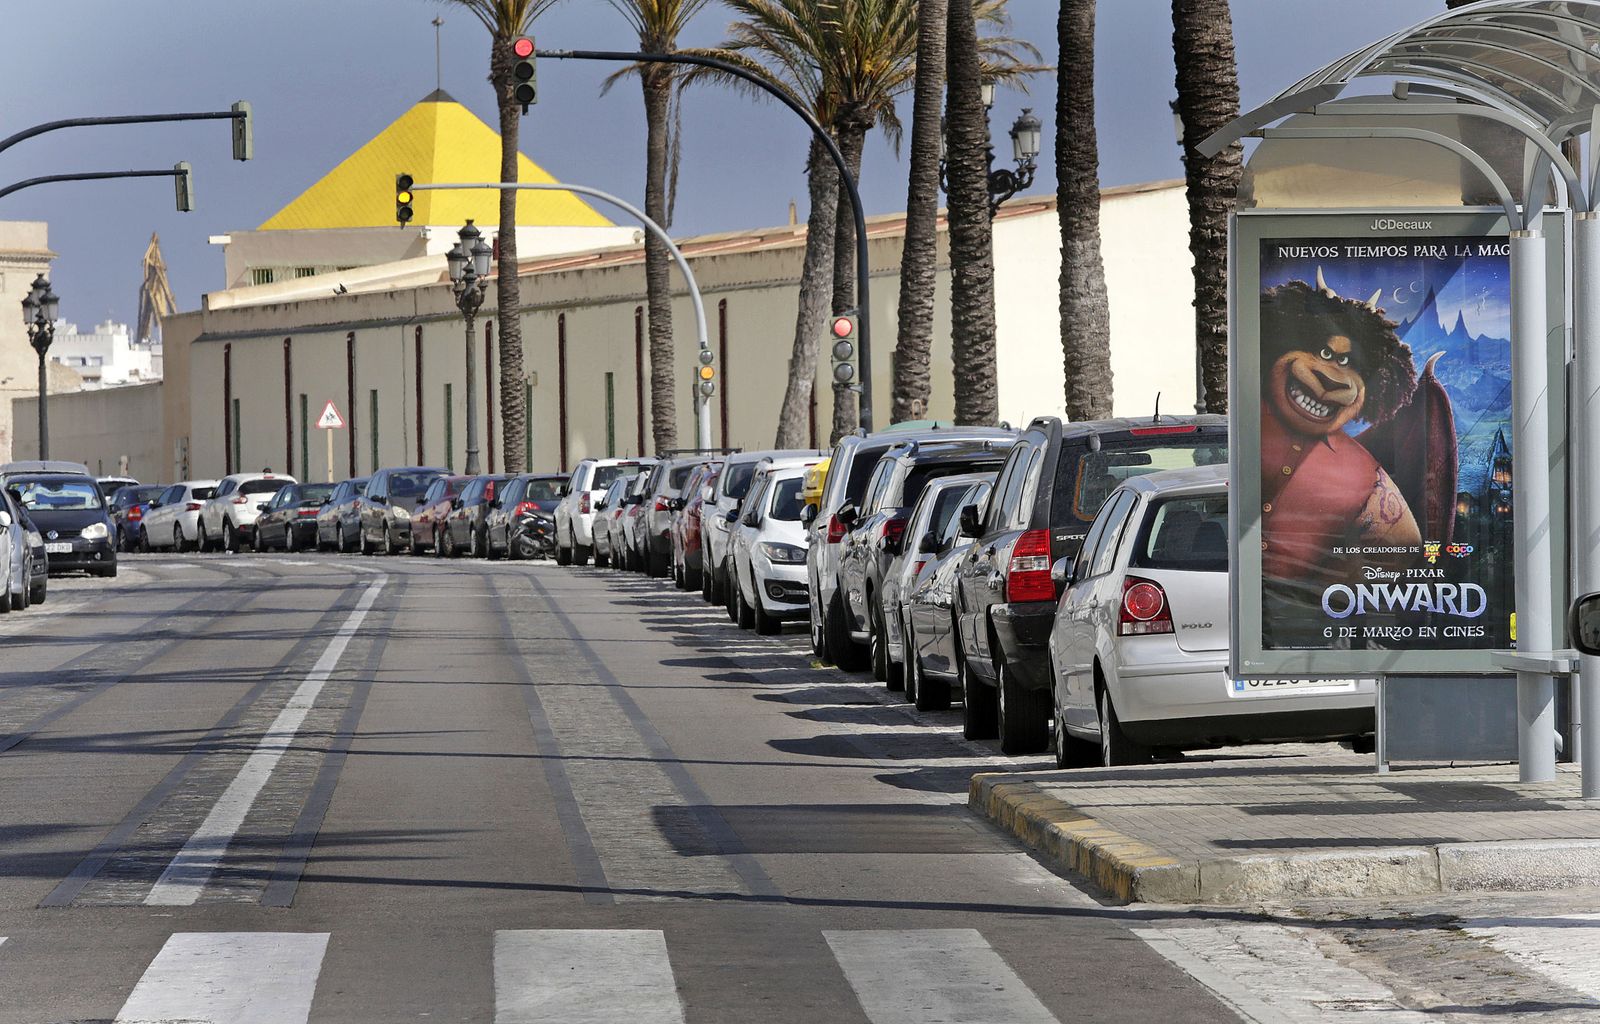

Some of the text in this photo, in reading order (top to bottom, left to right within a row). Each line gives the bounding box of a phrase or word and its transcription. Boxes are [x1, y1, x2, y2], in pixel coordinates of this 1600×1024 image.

[1371, 219, 1432, 231] JCDecaux
[1278, 244, 1510, 260] NUEVOS TIEMPOS PARA LA MAG
[1333, 546, 1343, 554] DE
[1345, 546, 1360, 554] LOS
[1362, 546, 1407, 554] CREADORES
[1423, 543, 1442, 552] TOY
[1446, 545, 1474, 553] COCO
[1427, 555, 1437, 564] 4
[1406, 568, 1445, 578] PIXAR
[1321, 582, 1487, 619] ONWARD
[1181, 622, 1213, 630] POLO
[1323, 625, 1485, 641] 6 DE MARZO EN CINES
